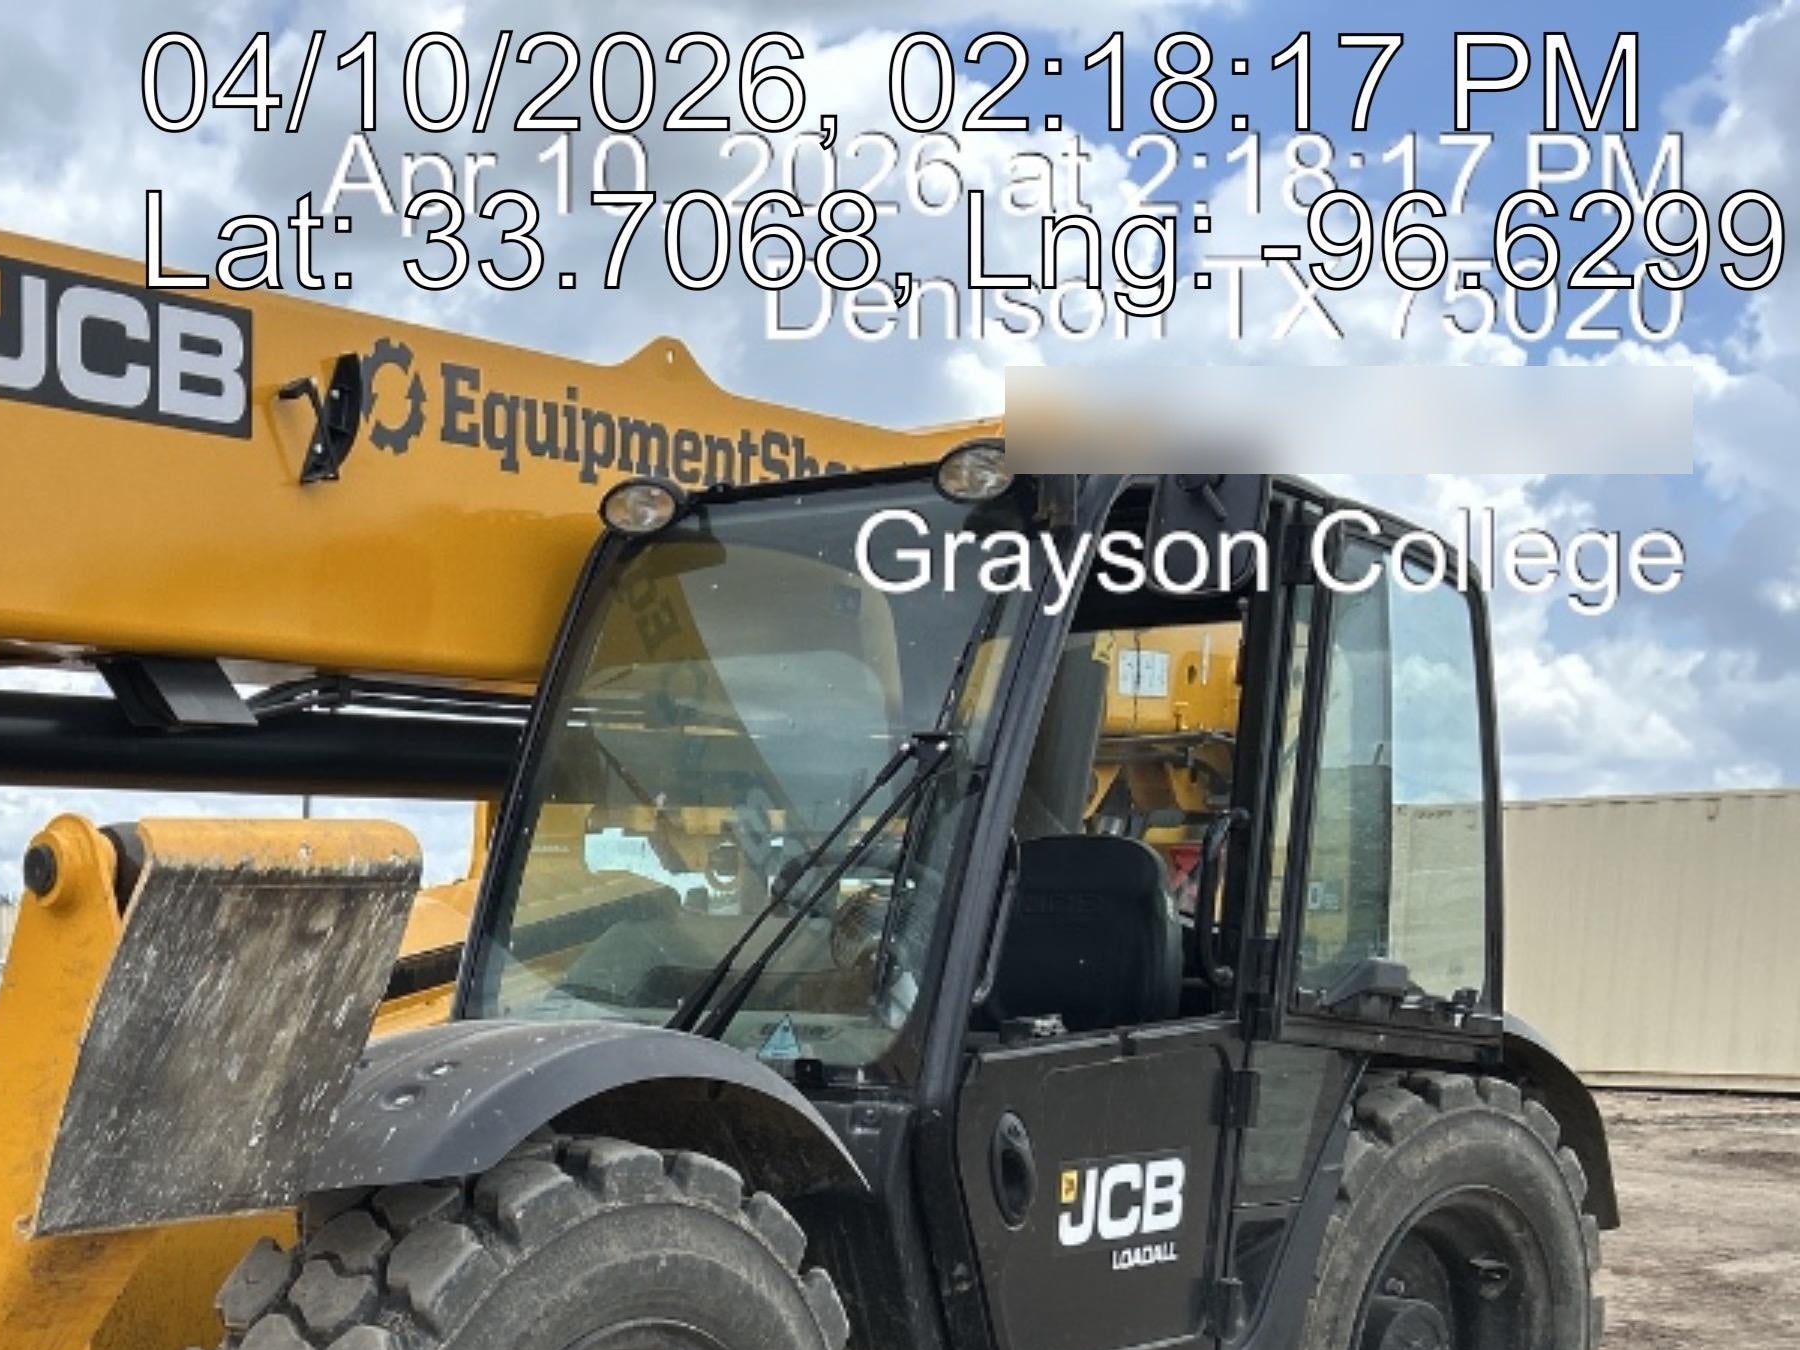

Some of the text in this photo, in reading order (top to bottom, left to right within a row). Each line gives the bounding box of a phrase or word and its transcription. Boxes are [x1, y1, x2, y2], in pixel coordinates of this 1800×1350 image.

[439, 362, 862, 485] EquipmentSh
[1058, 1158, 1186, 1246] JCB
[1111, 1241, 1178, 1271] LOADALL
